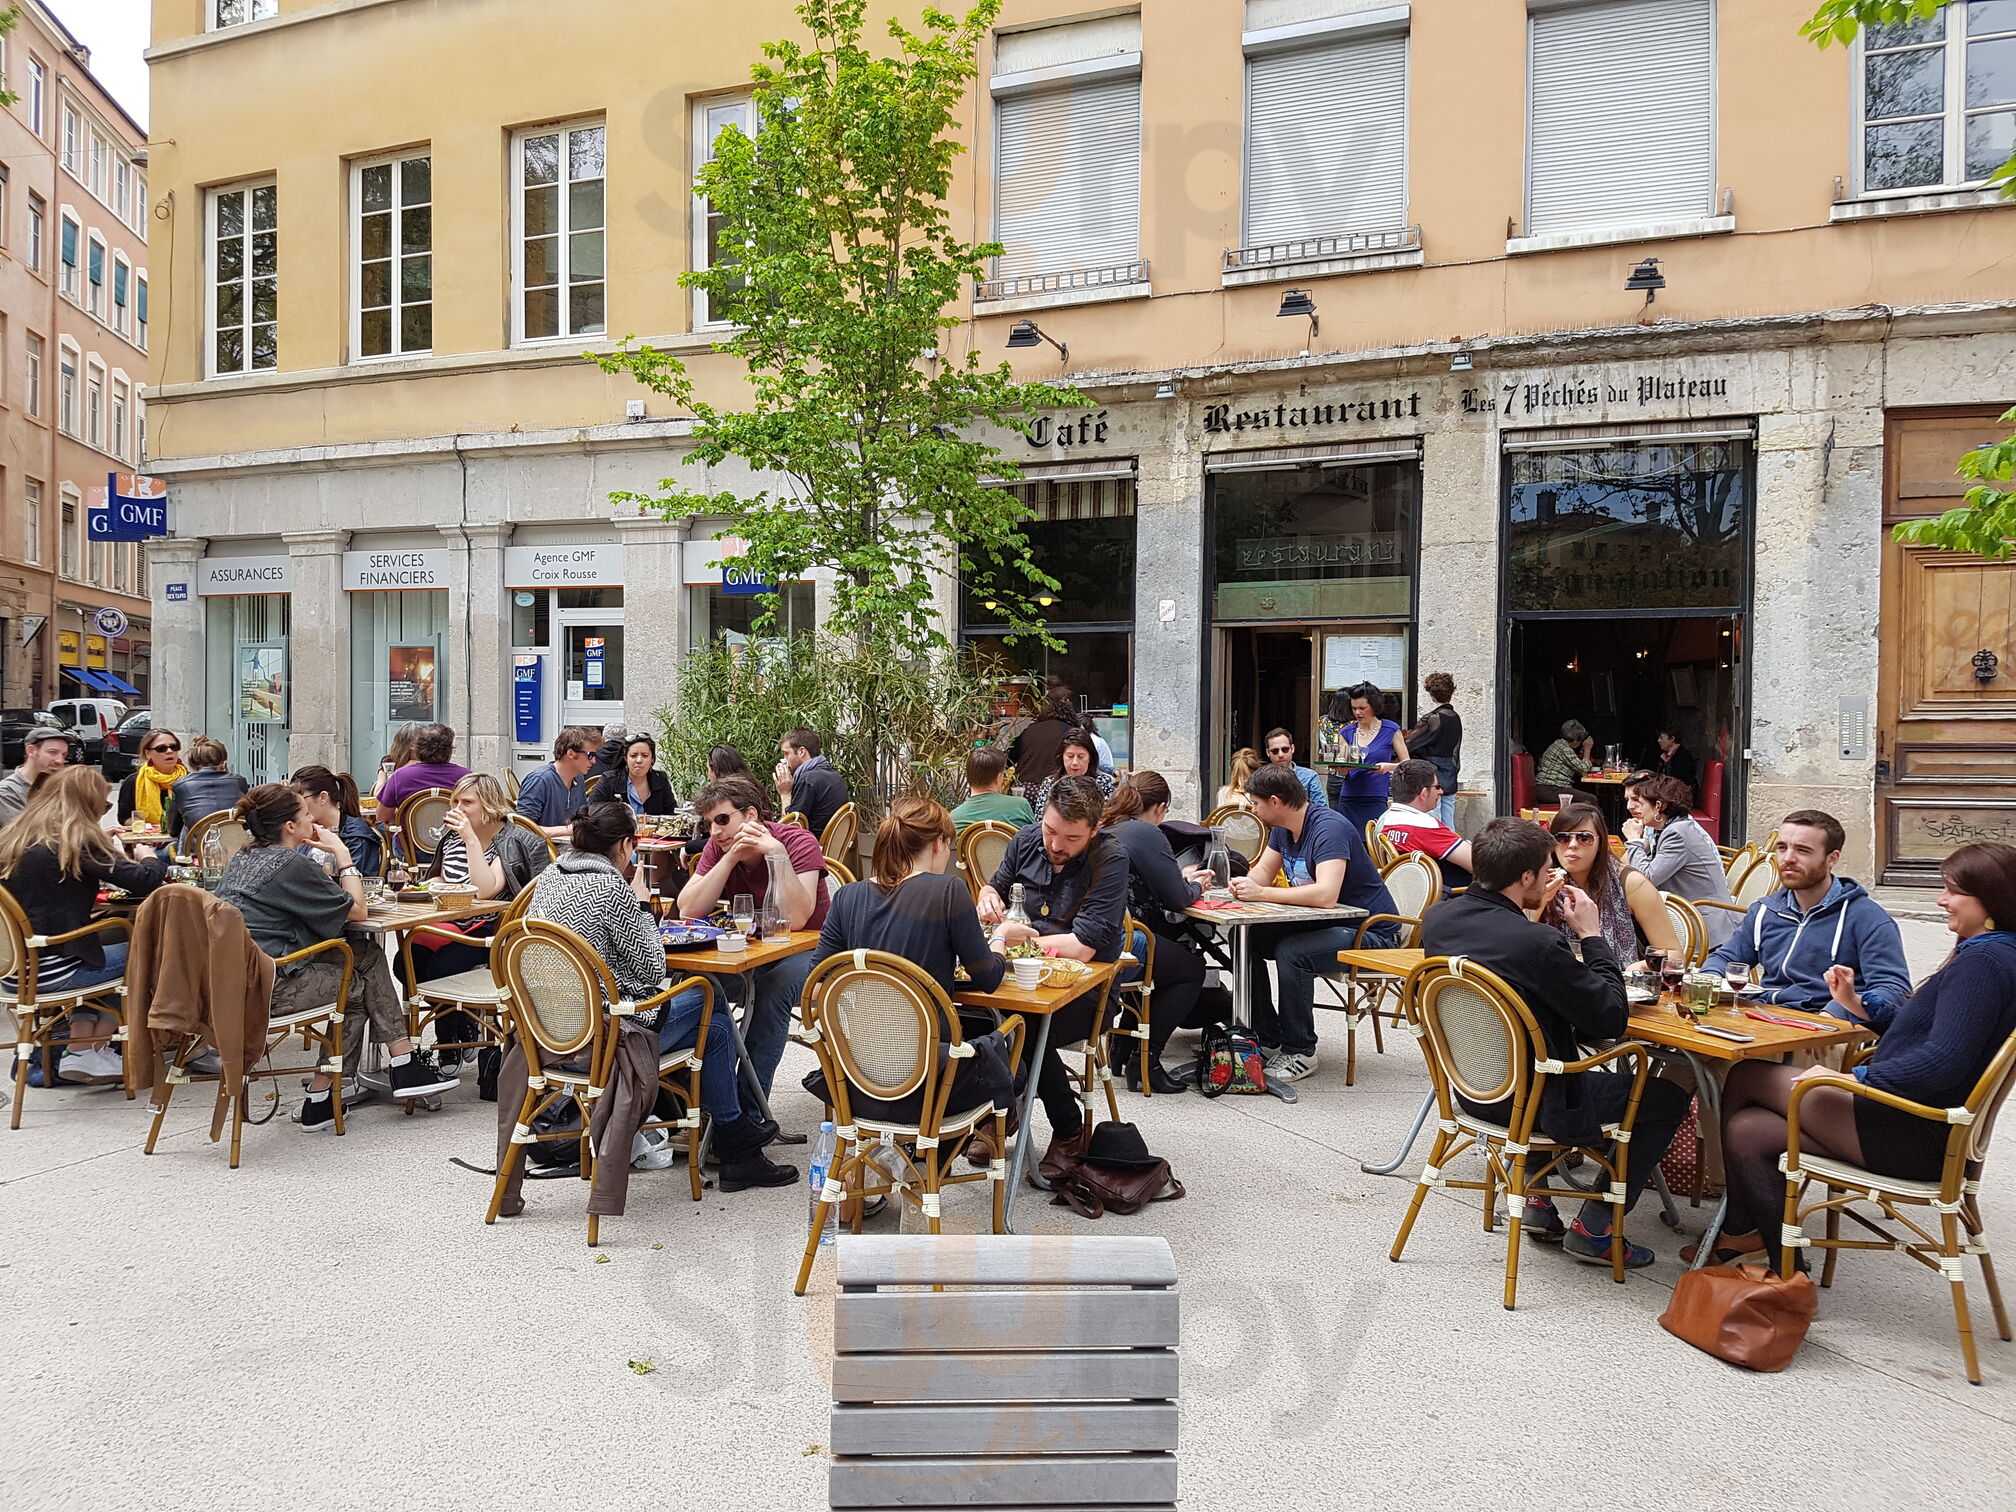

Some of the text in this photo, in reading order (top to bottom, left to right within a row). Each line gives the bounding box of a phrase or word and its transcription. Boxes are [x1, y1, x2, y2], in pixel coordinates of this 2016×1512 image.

[1462, 375, 1728, 415] Les 7 Péchés du Plateau
[1203, 391, 1422, 434] Restaurant
[1025, 409, 1109, 448] Café
[120, 503, 164, 527] GMF
[369, 553, 424, 568] SERVICES
[533, 550, 596, 566] Agence GMF
[210, 567, 283, 582] ASSURANCES
[360, 570, 435, 585] FINANCIERS
[532, 568, 598, 580] Croix Rousse
[586, 649, 603, 657] GMF
[516, 668, 536, 678] GMF
[884, 1132, 891, 1141] K
